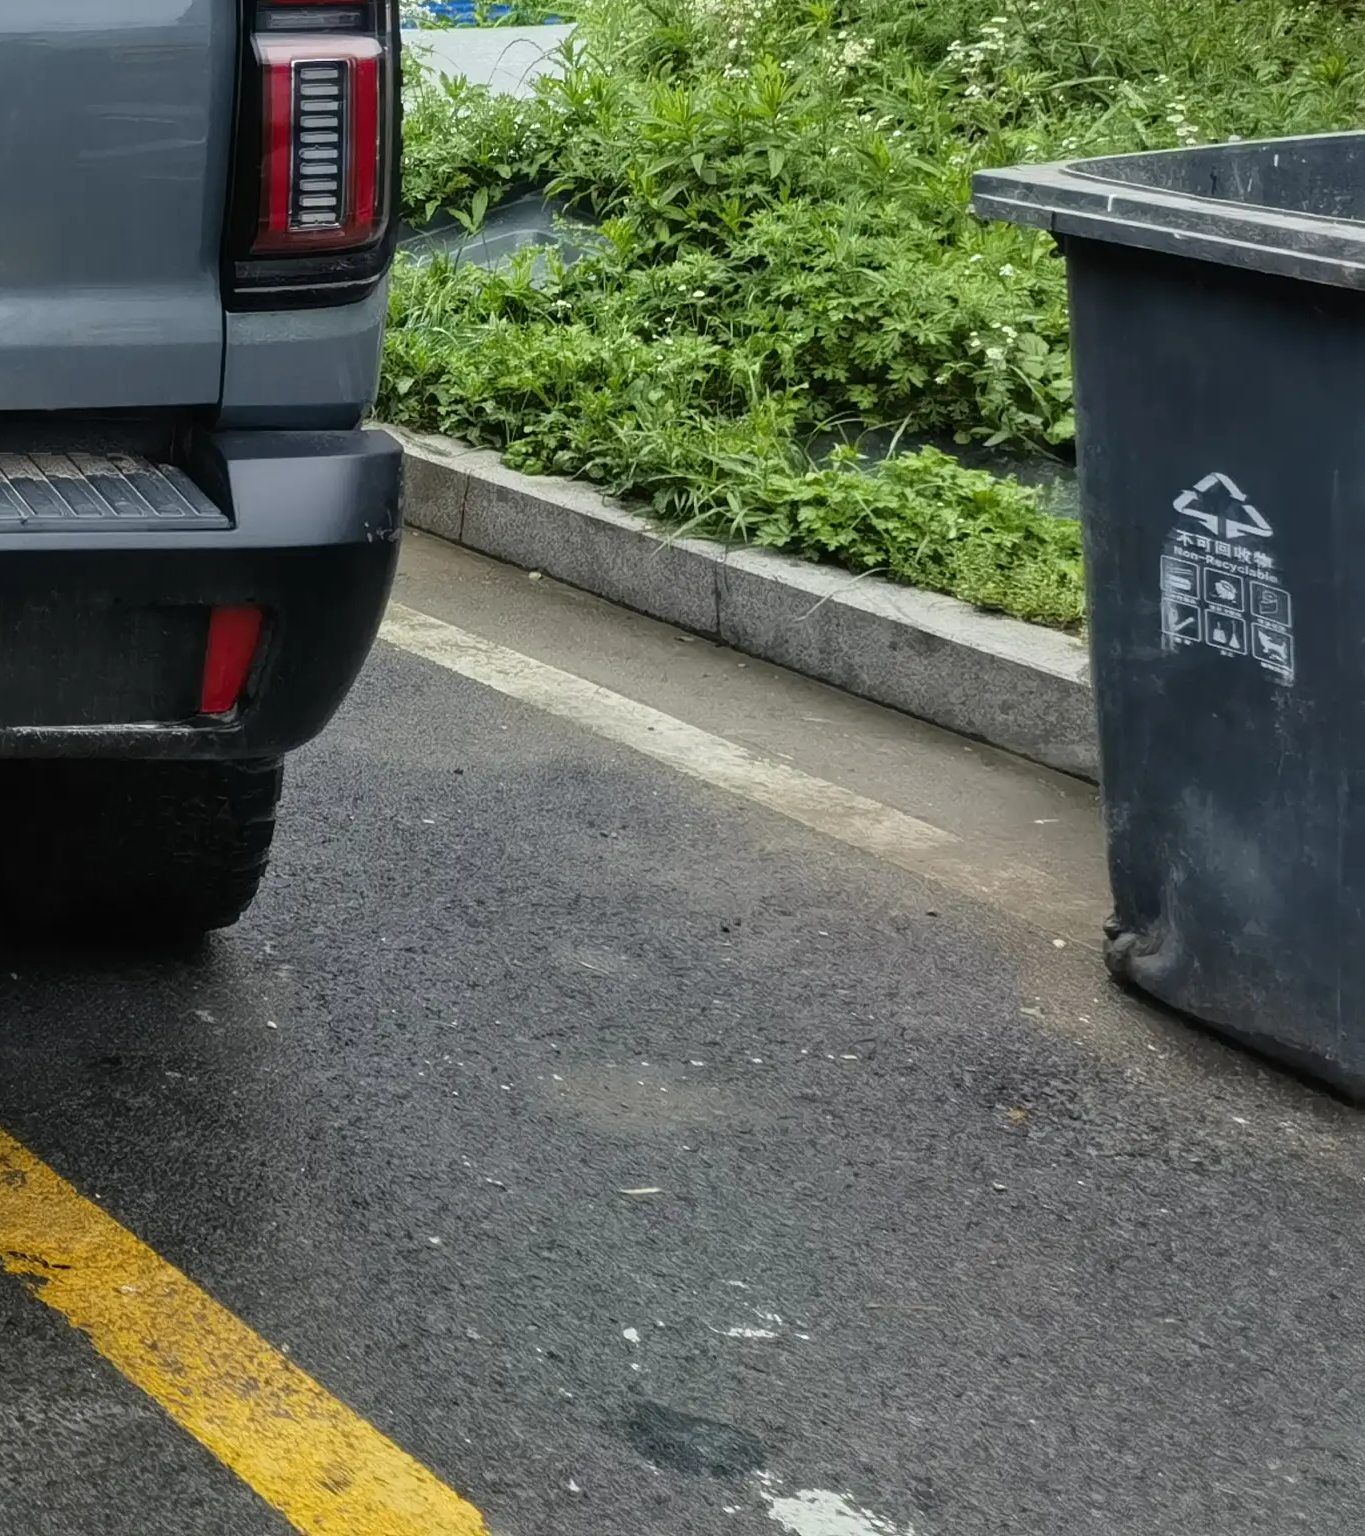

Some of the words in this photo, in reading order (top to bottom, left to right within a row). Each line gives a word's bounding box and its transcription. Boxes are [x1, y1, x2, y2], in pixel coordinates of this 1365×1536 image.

[1173, 546, 1279, 584] Non-Recyclable
[1175, 529, 1274, 569] 不可回收物
